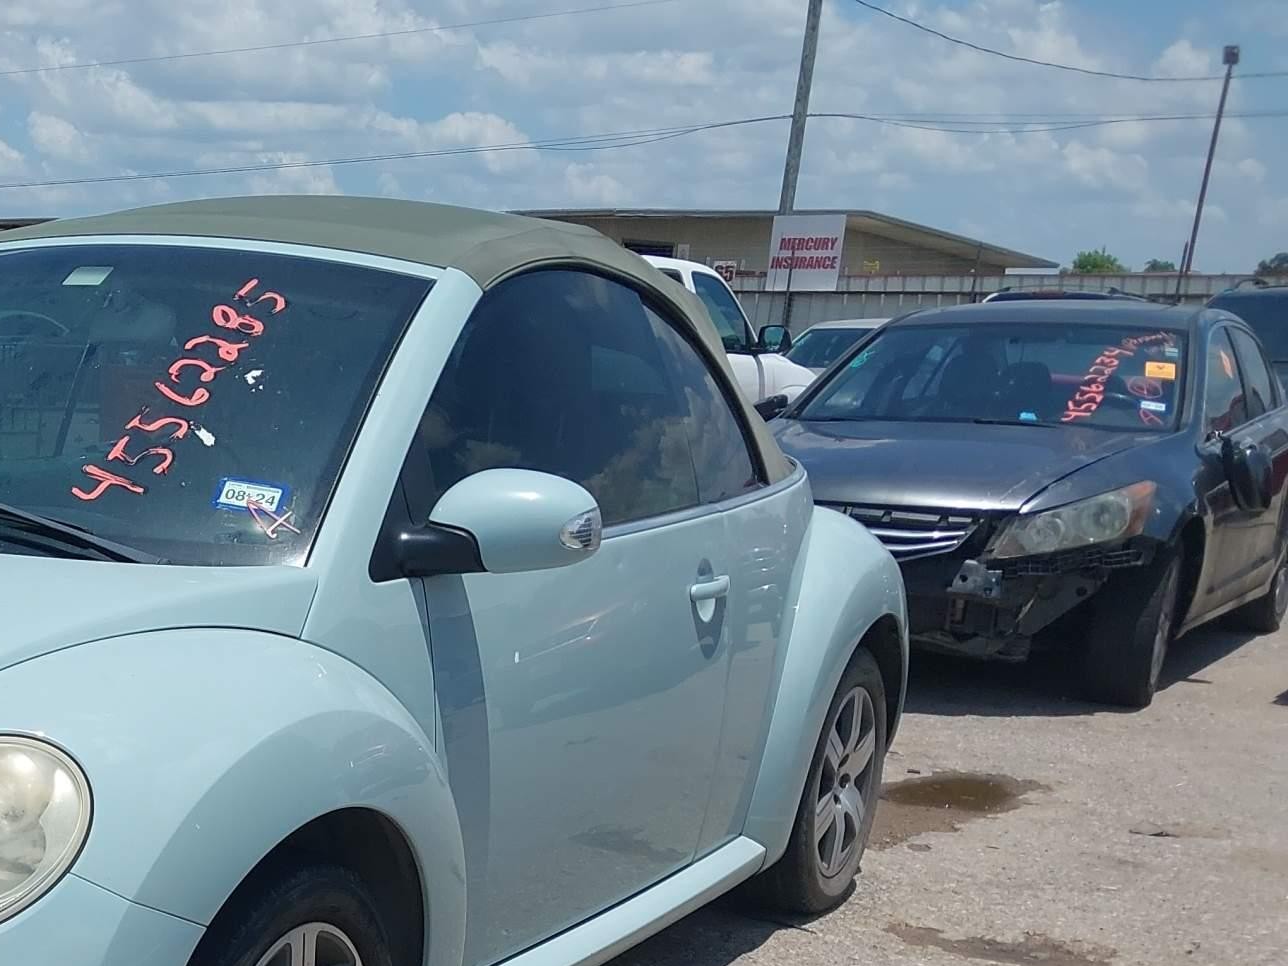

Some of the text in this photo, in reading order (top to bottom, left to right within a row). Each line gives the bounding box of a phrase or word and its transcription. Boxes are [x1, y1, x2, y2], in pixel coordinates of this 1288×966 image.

[770, 256, 838, 270] INSURANCE
[779, 236, 838, 251] MERCURY
[72, 279, 285, 499] 45562285
[1059, 346, 1135, 422] 45562234
